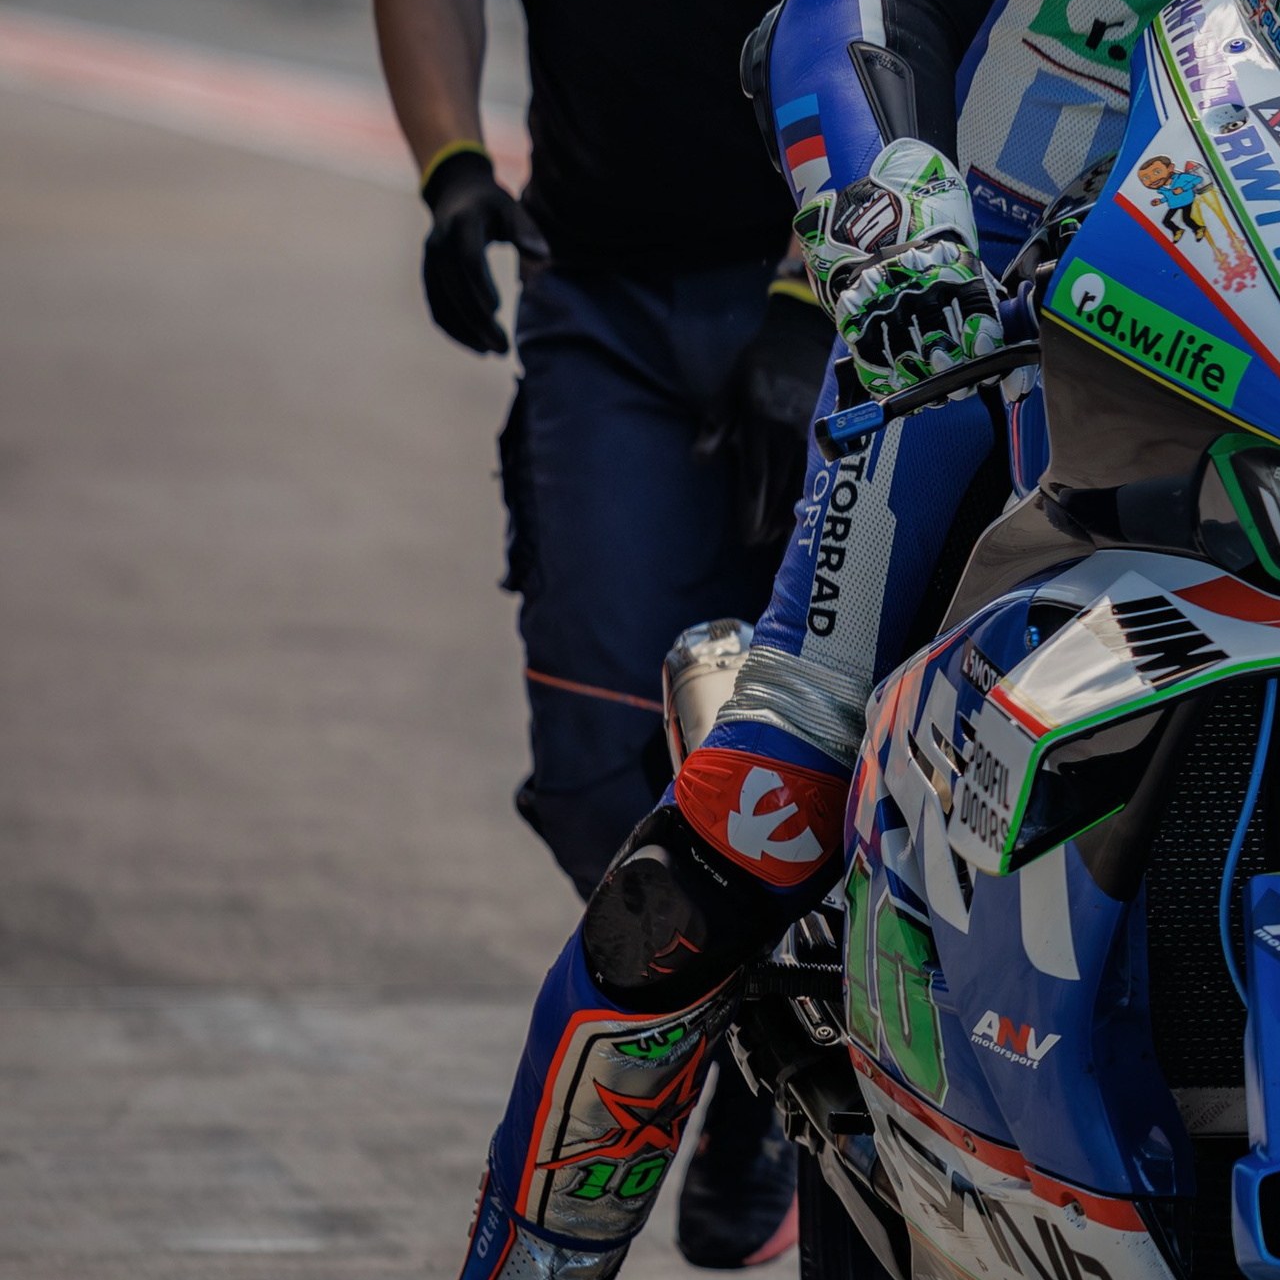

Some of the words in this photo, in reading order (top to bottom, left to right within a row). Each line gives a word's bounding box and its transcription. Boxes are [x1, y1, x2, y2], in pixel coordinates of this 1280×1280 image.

[1074, 287, 1227, 394] r.a.w.life
[798, 469, 832, 557] ORT
[807, 433, 873, 637] TORRAD
[970, 739, 1011, 812] PROFIL
[847, 846, 950, 1112] 10
[971, 1033, 1040, 1070] motorsport
[972, 1009, 1062, 1061] ANV
[570, 1156, 670, 1200] 10
